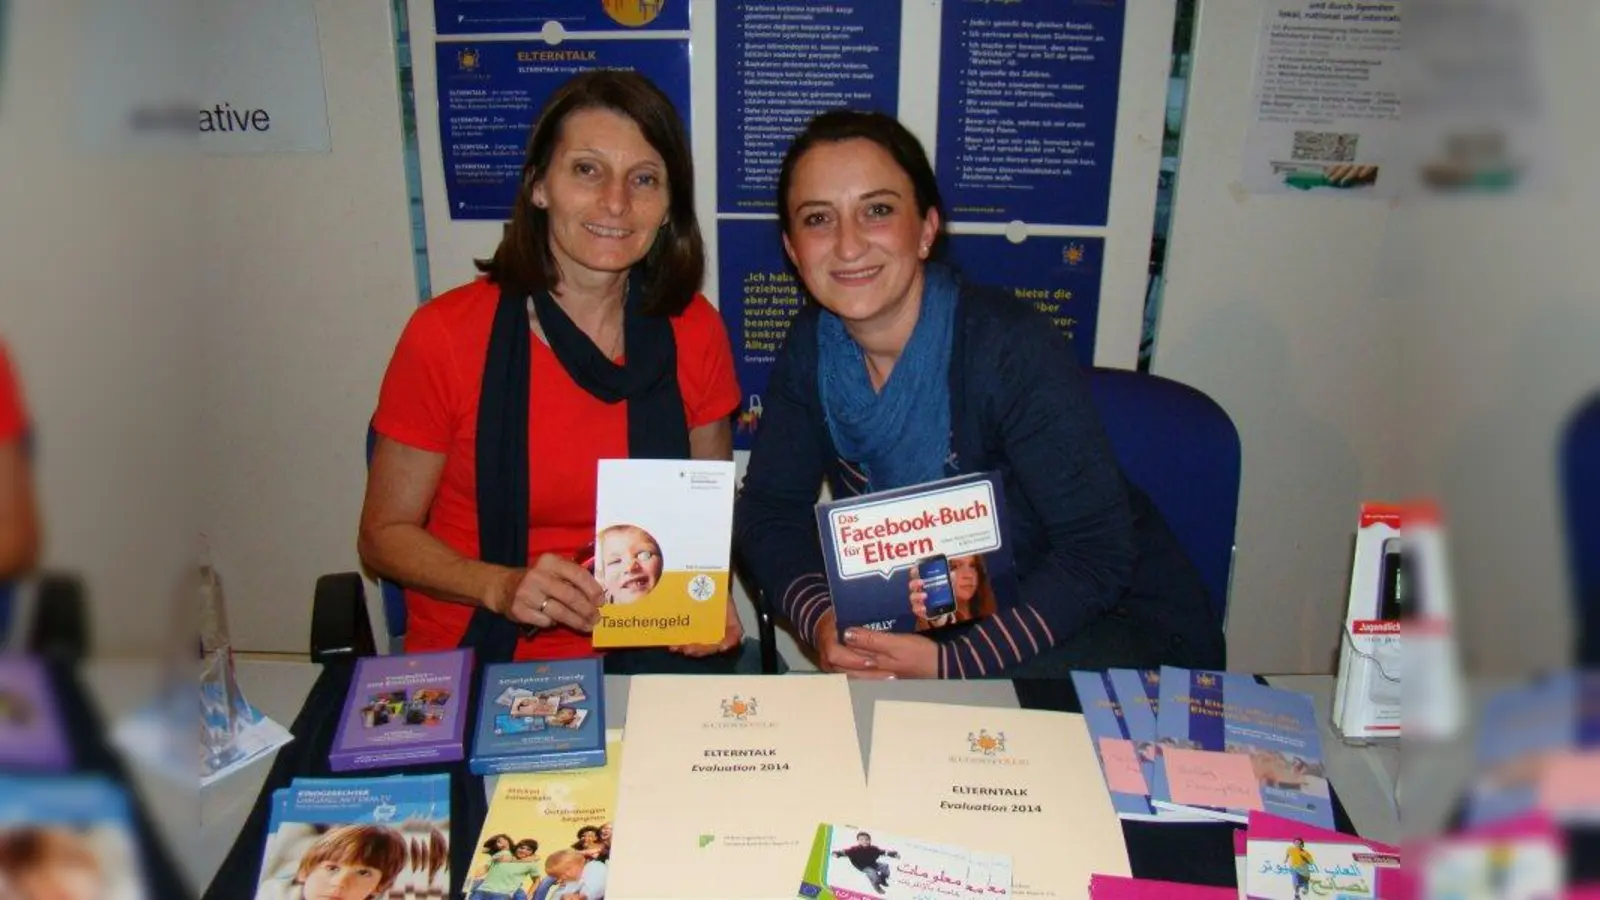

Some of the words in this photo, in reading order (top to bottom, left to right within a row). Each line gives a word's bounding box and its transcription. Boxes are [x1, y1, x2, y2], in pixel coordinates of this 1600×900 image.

[517, 51, 597, 62] ELTERNTALK
[198, 102, 270, 132] ative
[744, 285, 797, 296] erziehung
[1014, 288, 1050, 299] bietet
[1054, 288, 1073, 299] die
[744, 296, 768, 306] aber
[772, 296, 799, 306] beim
[744, 307, 785, 317] wurden
[744, 341, 776, 352] Alltag
[838, 513, 860, 525] Das
[840, 500, 989, 544] Facebook-Buch
[843, 546, 861, 558] für
[863, 536, 934, 565] Eltern
[600, 614, 691, 630] Taschengeld
[703, 748, 778, 758] ELTERNTALK
[691, 763, 757, 773] Evaluation
[759, 762, 790, 772] 2014
[952, 785, 1028, 796] ELTERNTALK
[940, 800, 1008, 813] Evaluation
[1011, 803, 1042, 813] 2014
